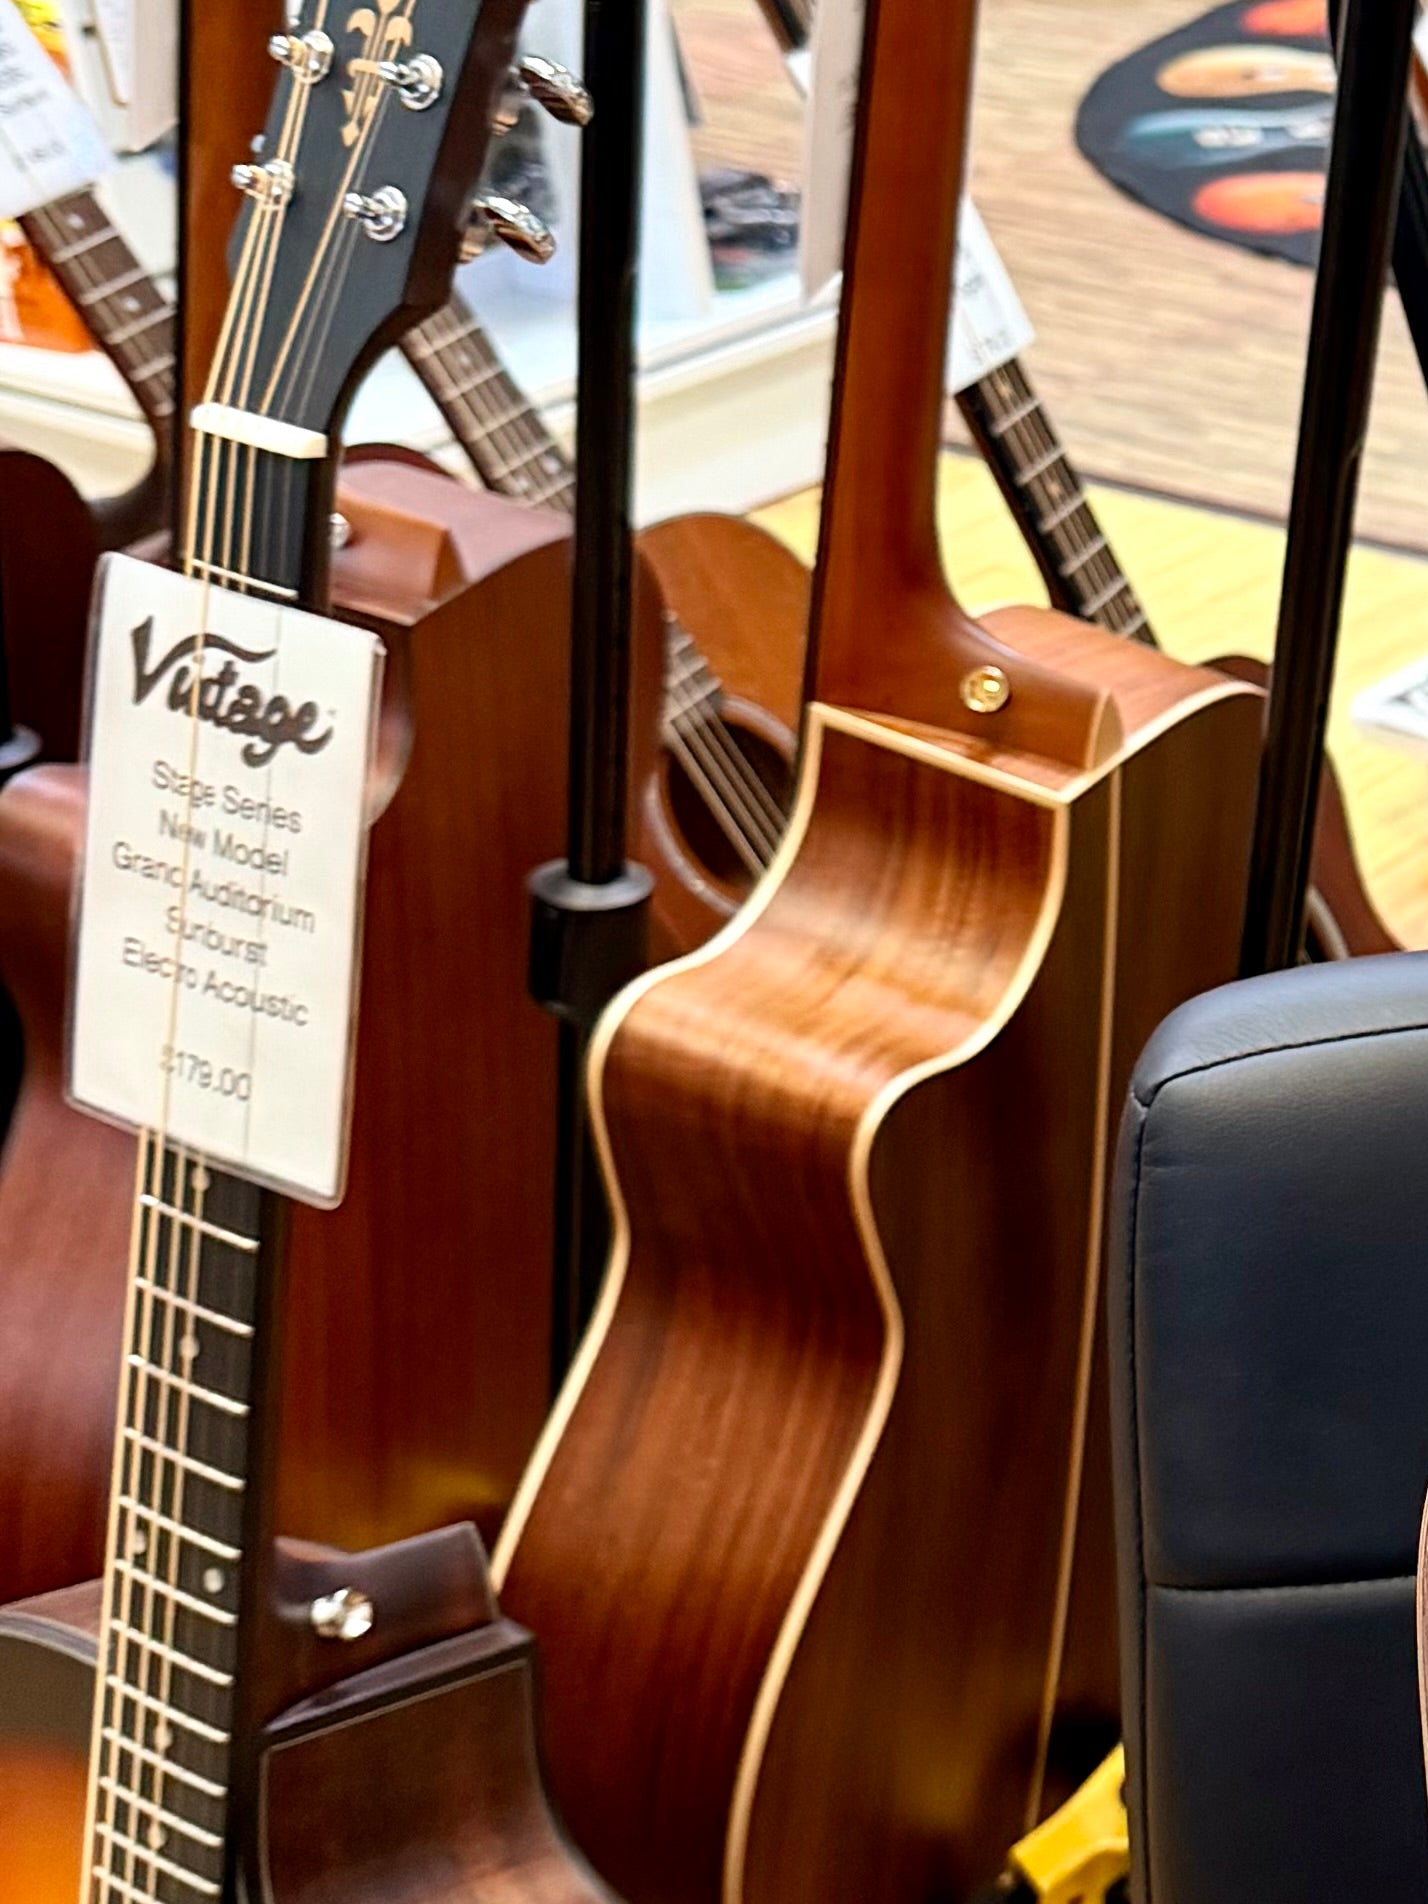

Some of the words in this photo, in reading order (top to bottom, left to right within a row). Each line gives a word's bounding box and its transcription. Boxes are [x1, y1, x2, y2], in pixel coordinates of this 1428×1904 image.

[130, 614, 335, 769] Vintage
[151, 760, 217, 809] Stage
[222, 784, 302, 834] Series
[159, 808, 207, 848] New
[213, 829, 290, 876] Model
[111, 840, 185, 888] Grand
[189, 868, 316, 934] Auditorium
[165, 905, 268, 967] Sunburst
[123, 936, 198, 989] Electro
[203, 969, 309, 1026] Acoustic
